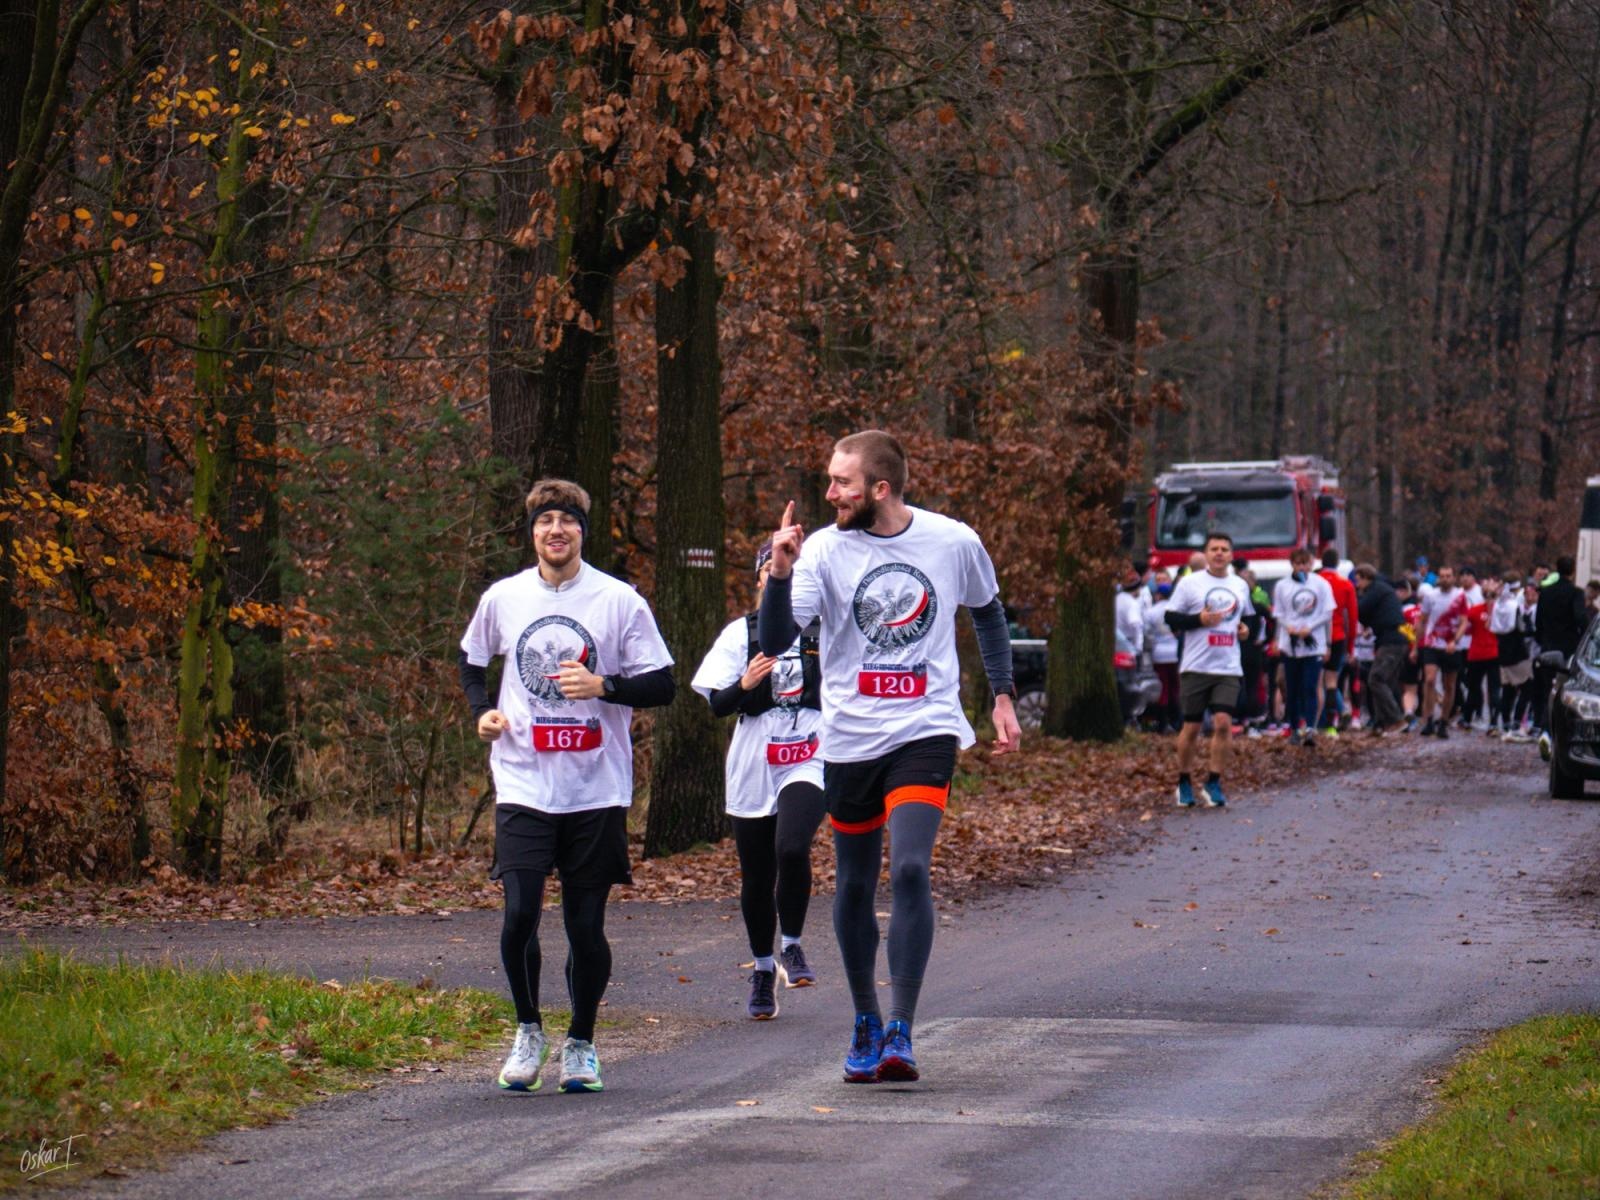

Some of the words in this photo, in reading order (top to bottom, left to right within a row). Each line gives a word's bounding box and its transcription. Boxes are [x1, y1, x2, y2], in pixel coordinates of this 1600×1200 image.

[872, 675, 915, 694] 120
[545, 729, 586, 748] 167
[778, 743, 811, 763] 073
